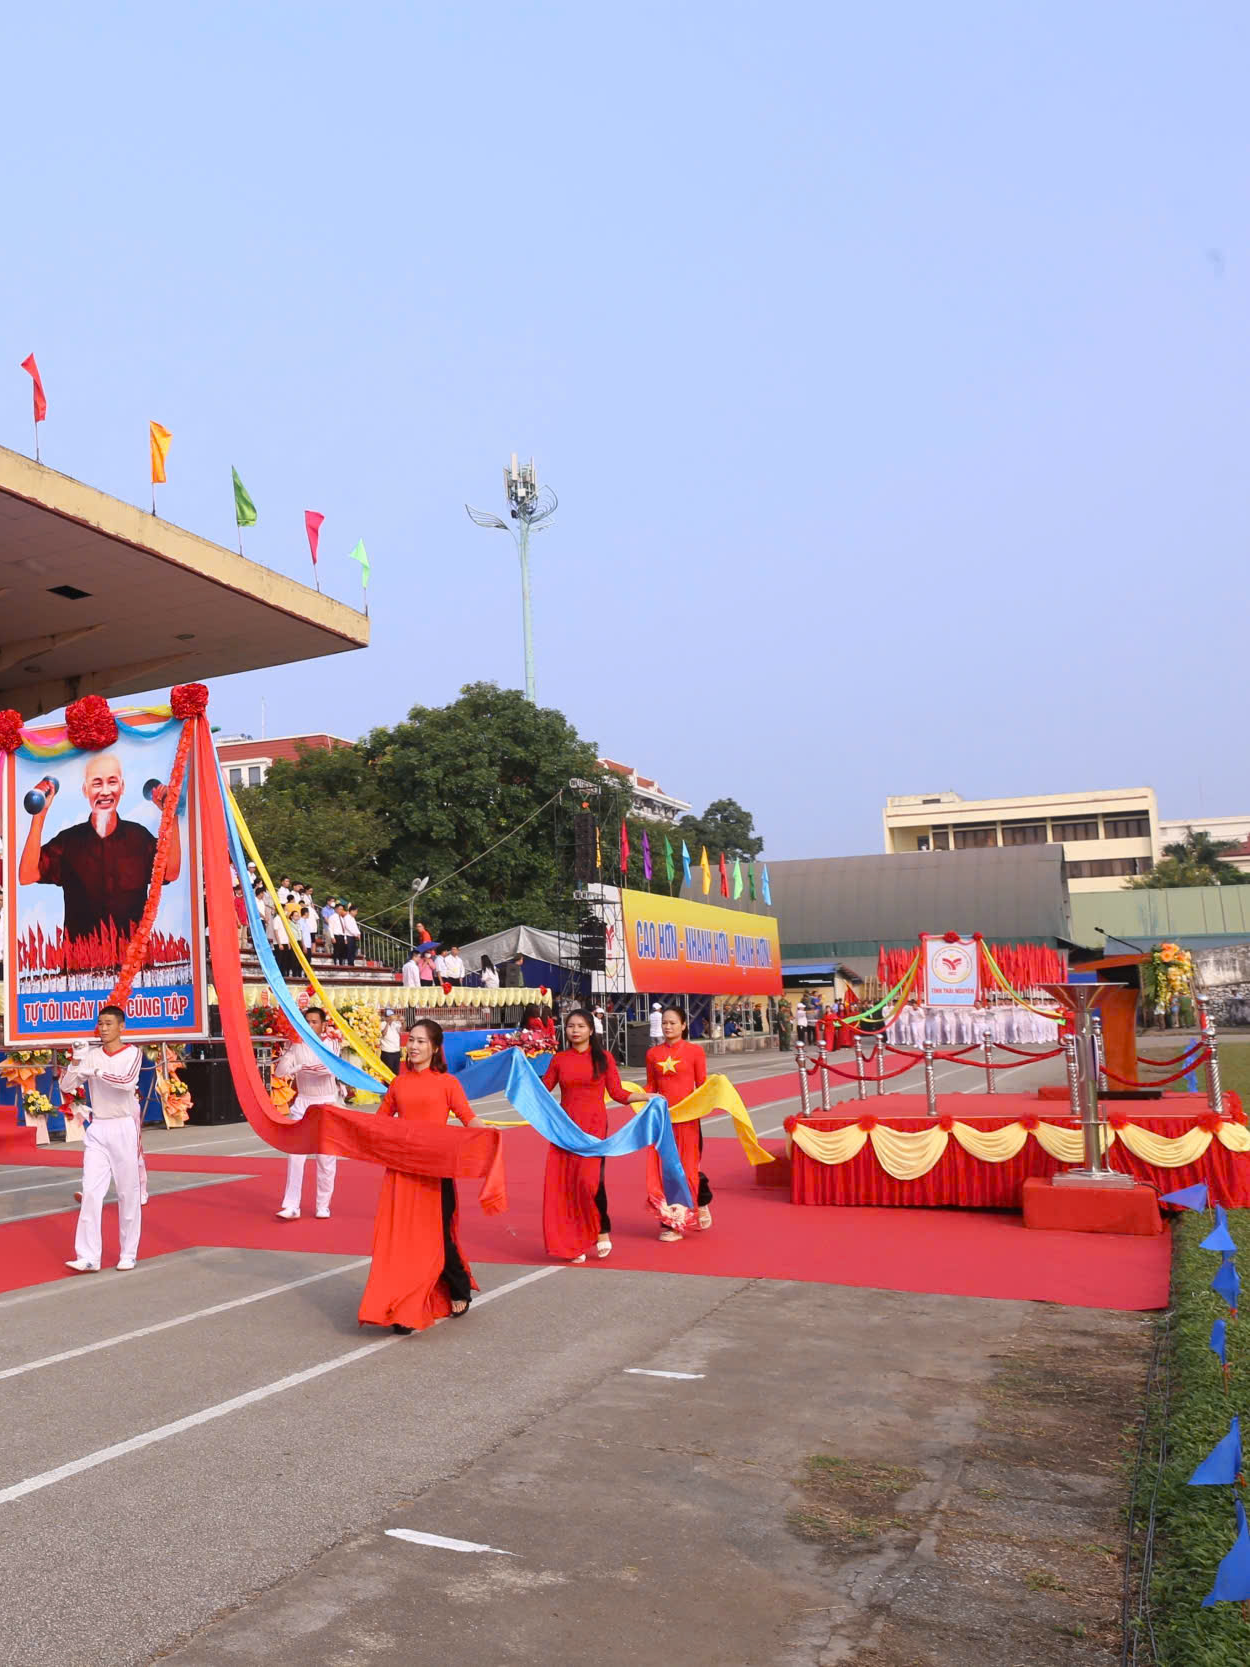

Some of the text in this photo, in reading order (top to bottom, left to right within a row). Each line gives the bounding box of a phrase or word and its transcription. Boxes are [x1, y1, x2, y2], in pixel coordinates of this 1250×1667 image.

[637, 920, 656, 959] CAO
[685, 926, 713, 965] NHANH
[23, 1001, 41, 1027] TỰ
[41, 998, 60, 1022] TÔI
[62, 997, 95, 1021] NGÀY
[125, 994, 161, 1019] CŨNG
[163, 992, 189, 1020] TẬP
